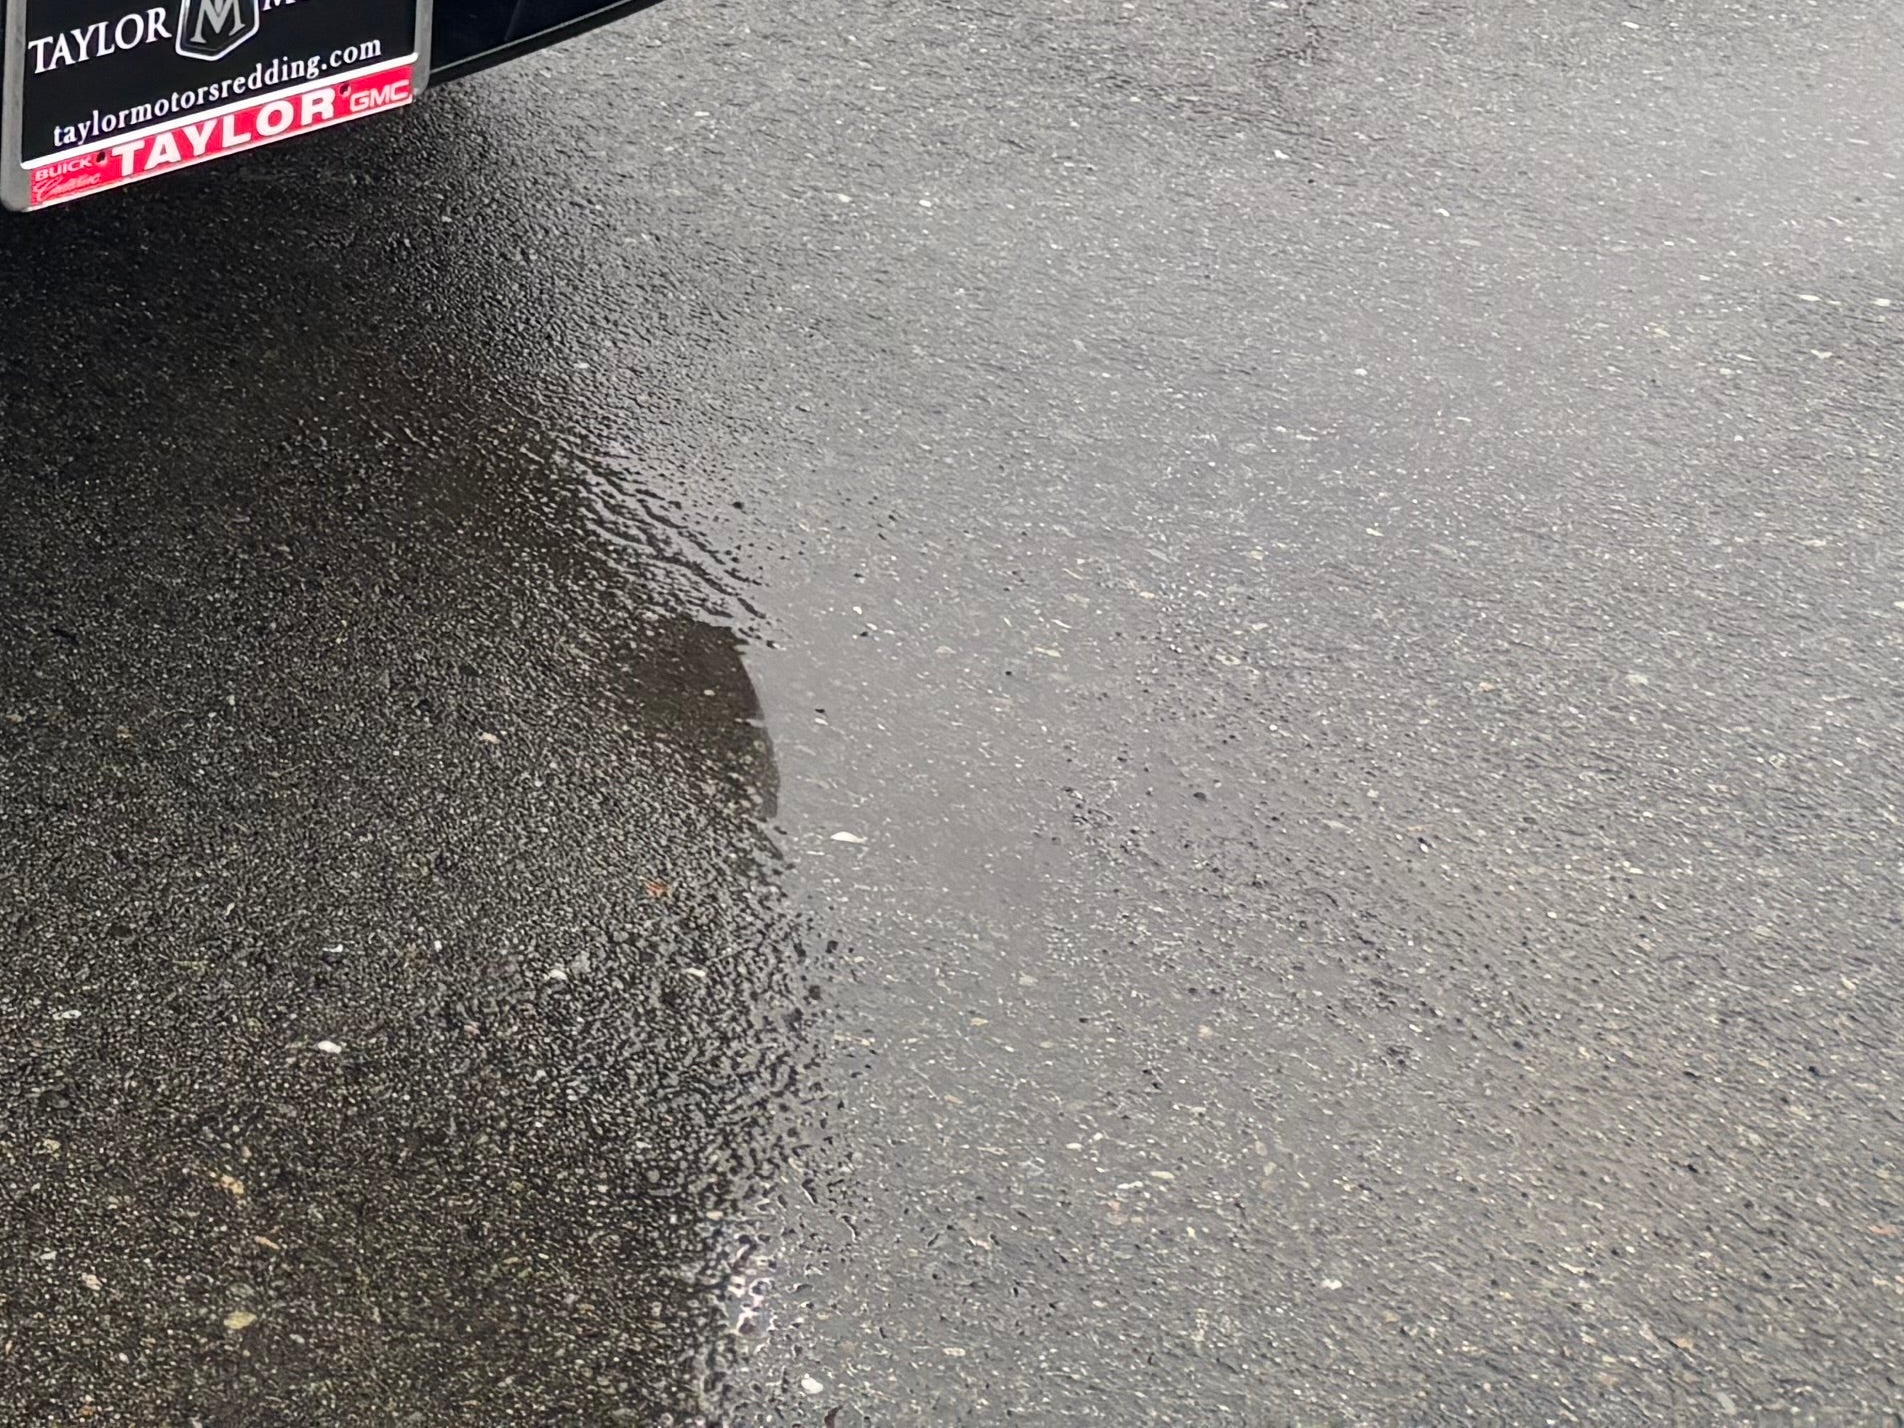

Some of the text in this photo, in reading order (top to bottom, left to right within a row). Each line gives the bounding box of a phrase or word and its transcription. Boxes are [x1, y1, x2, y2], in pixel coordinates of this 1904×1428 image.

[28, 7, 173, 75] TAYLOR
[53, 39, 382, 147] taylormotorsredding.com
[349, 79, 410, 114] GMC
[112, 85, 336, 177] TAYLOR
[35, 155, 92, 182] BUICK
